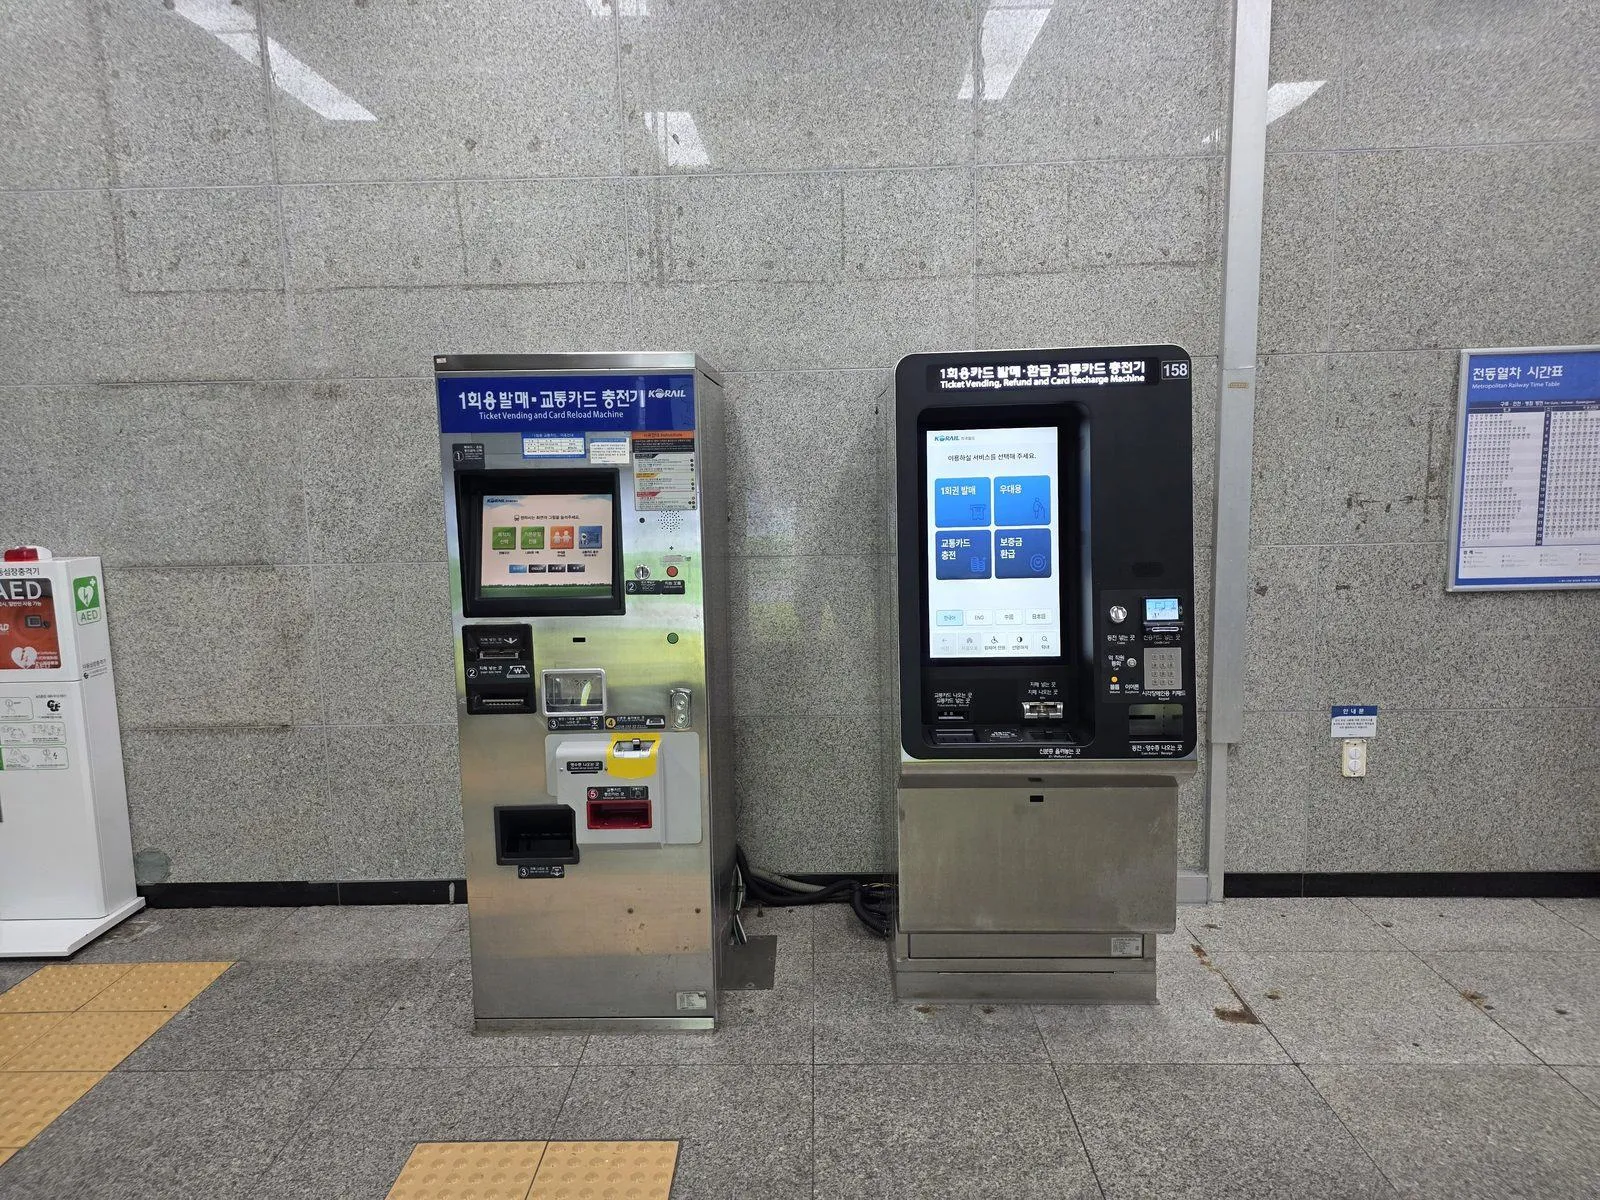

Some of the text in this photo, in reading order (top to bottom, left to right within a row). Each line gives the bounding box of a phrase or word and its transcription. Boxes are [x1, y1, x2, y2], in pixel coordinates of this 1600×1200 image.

[940, 366, 994, 380] 1회용카드
[1109, 361, 1145, 375] 충전기
[1163, 363, 1188, 376] 158
[1472, 365, 1563, 380] 전동열차 시간표
[966, 380, 1002, 389] Vending,
[1034, 378, 1049, 386] and
[1051, 376, 1070, 385] Card
[1072, 376, 1108, 385] Recharge
[1110, 374, 1145, 382] Machine
[648, 388, 686, 398] KORAIL
[459, 391, 496, 410] 1회용
[602, 389, 645, 409] 충전기
[503, 412, 532, 420] Vending
[549, 411, 565, 419] Card
[940, 485, 976, 496] 1회권 발매
[1000, 484, 1022, 494] 우대용
[941, 538, 971, 548] 교통카드
[1000, 537, 1022, 547] 보증금
[941, 551, 956, 560] 충전
[1000, 549, 1015, 559] 환급
[81, 610, 98, 621] AED
